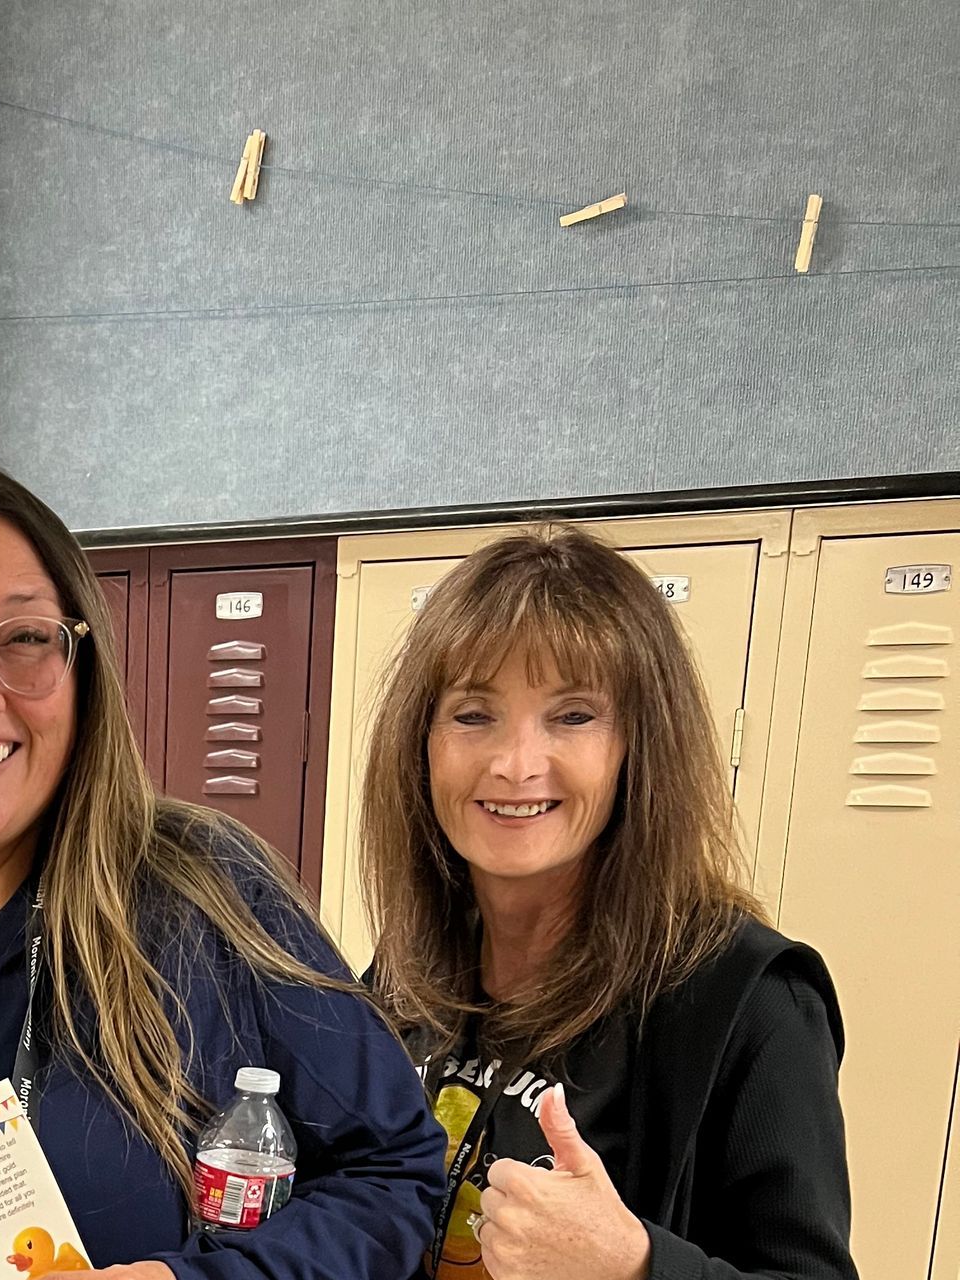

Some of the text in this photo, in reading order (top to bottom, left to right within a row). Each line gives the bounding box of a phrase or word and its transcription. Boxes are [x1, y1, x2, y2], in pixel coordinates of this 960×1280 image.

[902, 571, 934, 590] 149
[229, 599, 251, 614] 146
[451, 1142, 471, 1177] North
